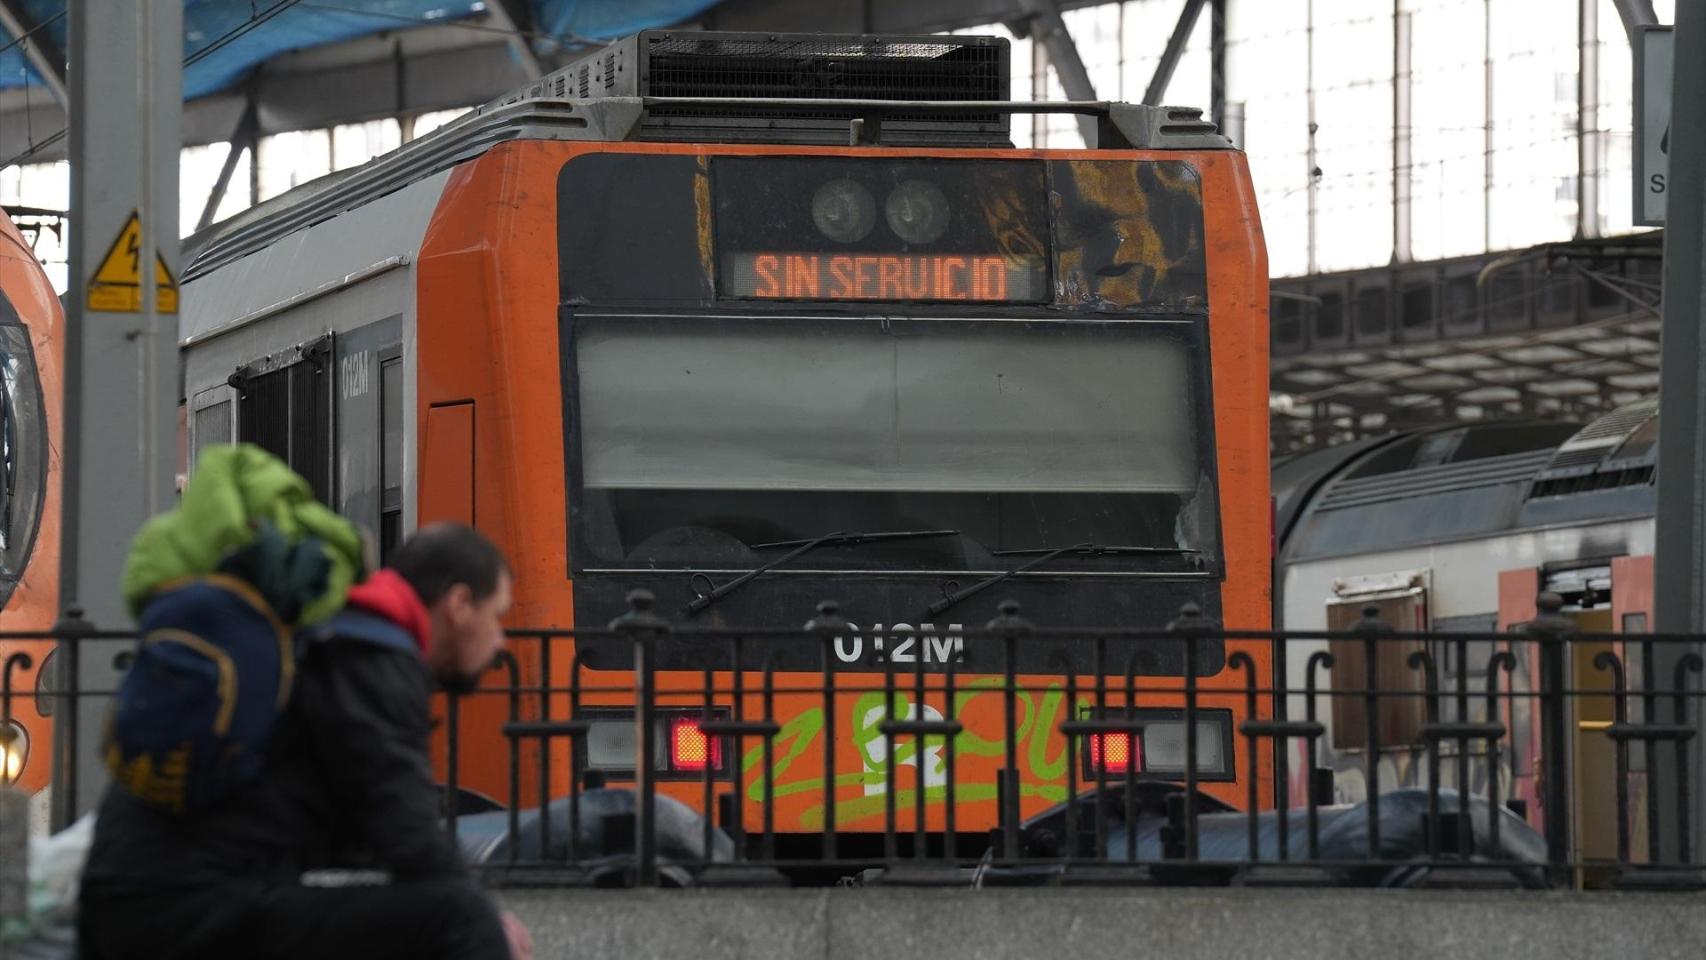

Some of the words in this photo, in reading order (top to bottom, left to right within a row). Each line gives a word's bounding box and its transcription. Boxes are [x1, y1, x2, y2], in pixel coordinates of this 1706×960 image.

[1650, 174, 1666, 194] S
[755, 255, 818, 297] SIN
[829, 256, 1007, 300] SERVICIO
[342, 350, 368, 400] 012M
[834, 622, 964, 663] 012M
